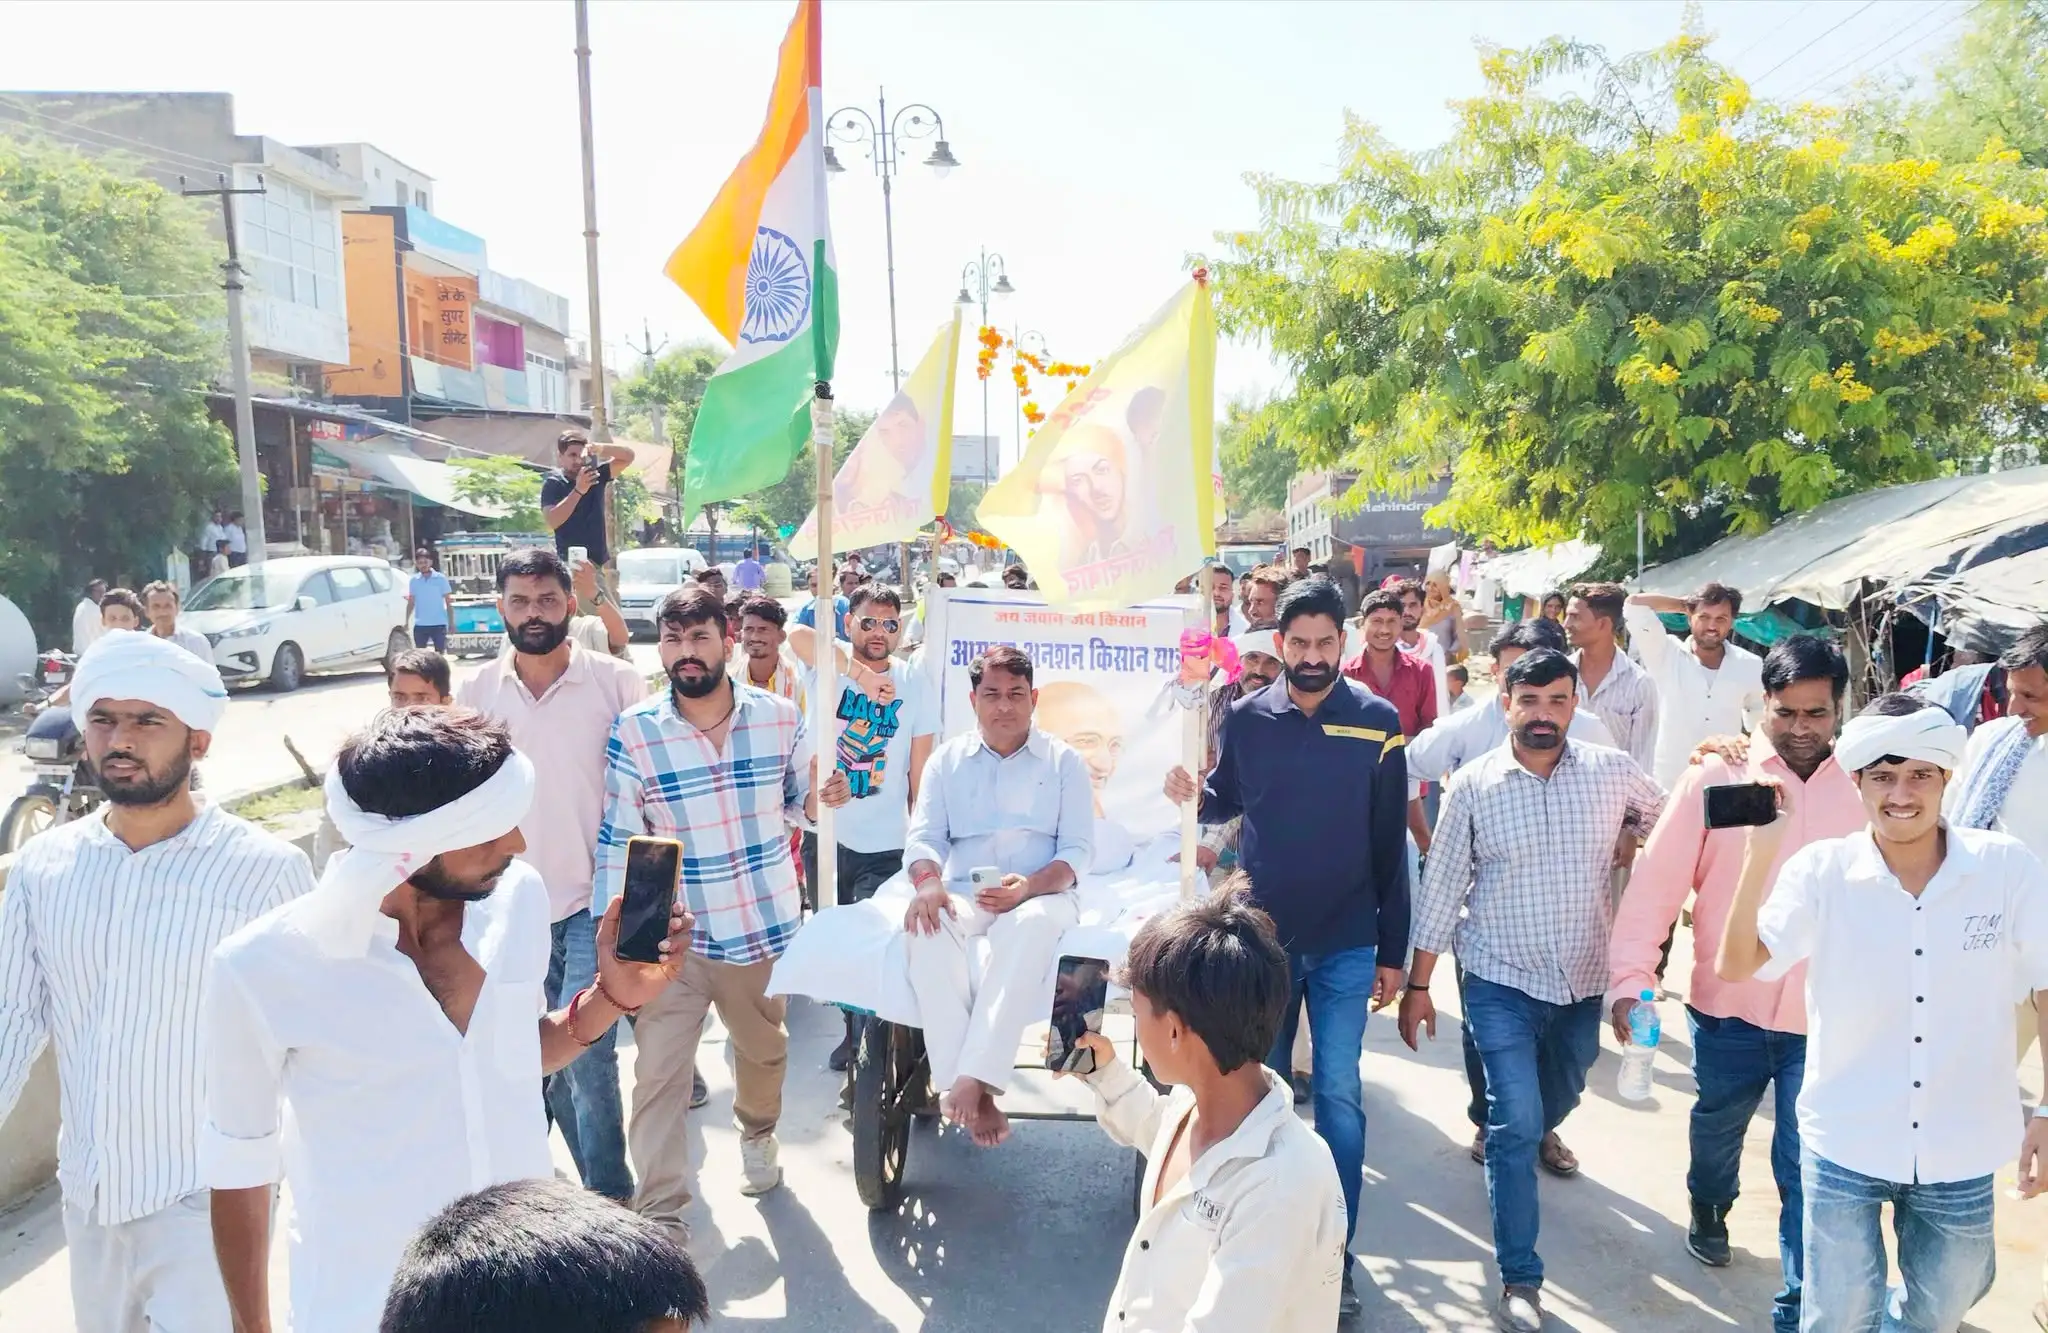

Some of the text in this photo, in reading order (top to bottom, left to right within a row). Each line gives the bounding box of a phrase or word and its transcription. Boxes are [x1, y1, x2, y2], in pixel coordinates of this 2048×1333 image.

[995, 611, 1019, 623] जय
[1099, 611, 1148, 627] किसान
[1024, 641, 1085, 670] अनशन
[1089, 637, 1149, 672] किसान
[836, 686, 903, 729] BACK
